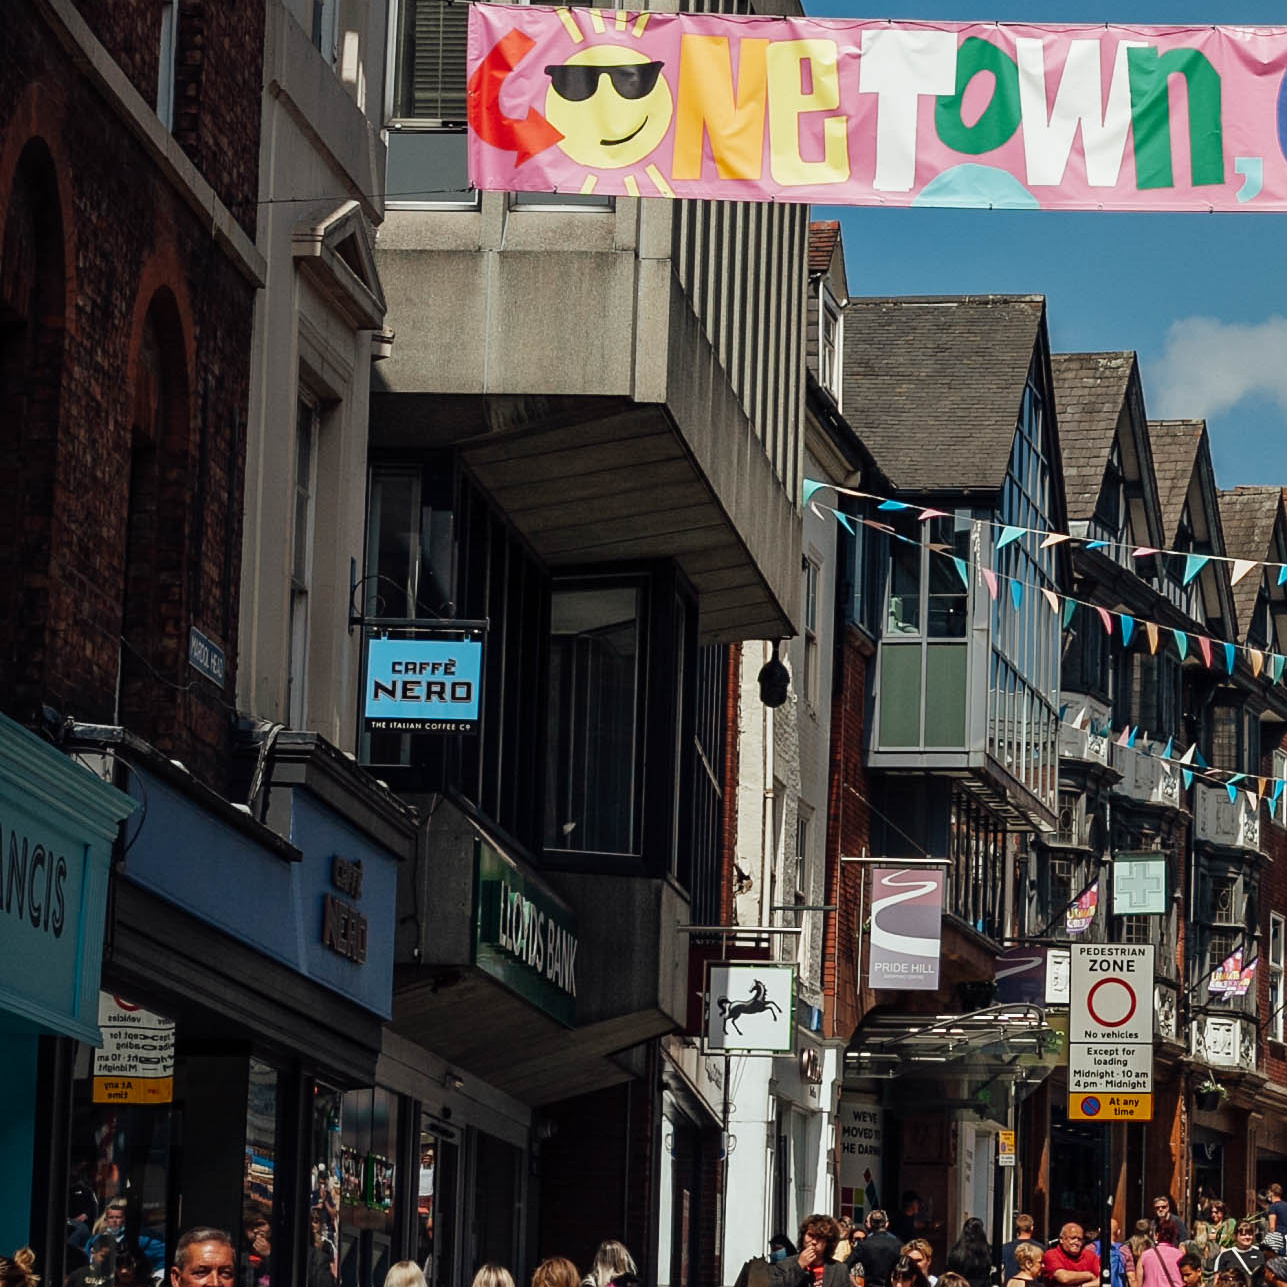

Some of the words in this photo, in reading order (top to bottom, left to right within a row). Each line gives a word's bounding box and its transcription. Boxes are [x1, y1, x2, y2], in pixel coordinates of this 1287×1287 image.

[373, 679, 472, 703] NERO
[389, 721, 422, 729] ITALIAN
[424, 722, 456, 730] COFFEE
[0, 830, 67, 938] NCIS
[323, 893, 368, 965] NERO
[499, 881, 545, 973] LLOYDS
[547, 918, 578, 998] BANK
[1079, 947, 1146, 956] PEDESTRIAN
[874, 962, 909, 973] PRIDE
[911, 963, 935, 974] HILL
[1088, 959, 1136, 972] ZONE
[1084, 1030, 1098, 1039] No
[1101, 1030, 1139, 1039] vehicles
[1087, 1047, 1119, 1056] Except
[1122, 1047, 1136, 1056] for
[1093, 1058, 1128, 1067] loading
[1073, 1069, 1114, 1079] Midnight
[1122, 1070, 1133, 1078] 10
[1074, 1080, 1081, 1088] 4
[1083, 1081, 1098, 1089] pm
[1105, 1080, 1147, 1089] Midnight
[1109, 1097, 1120, 1105] At
[1123, 1098, 1140, 1107] any
[1114, 1108, 1135, 1116] time
